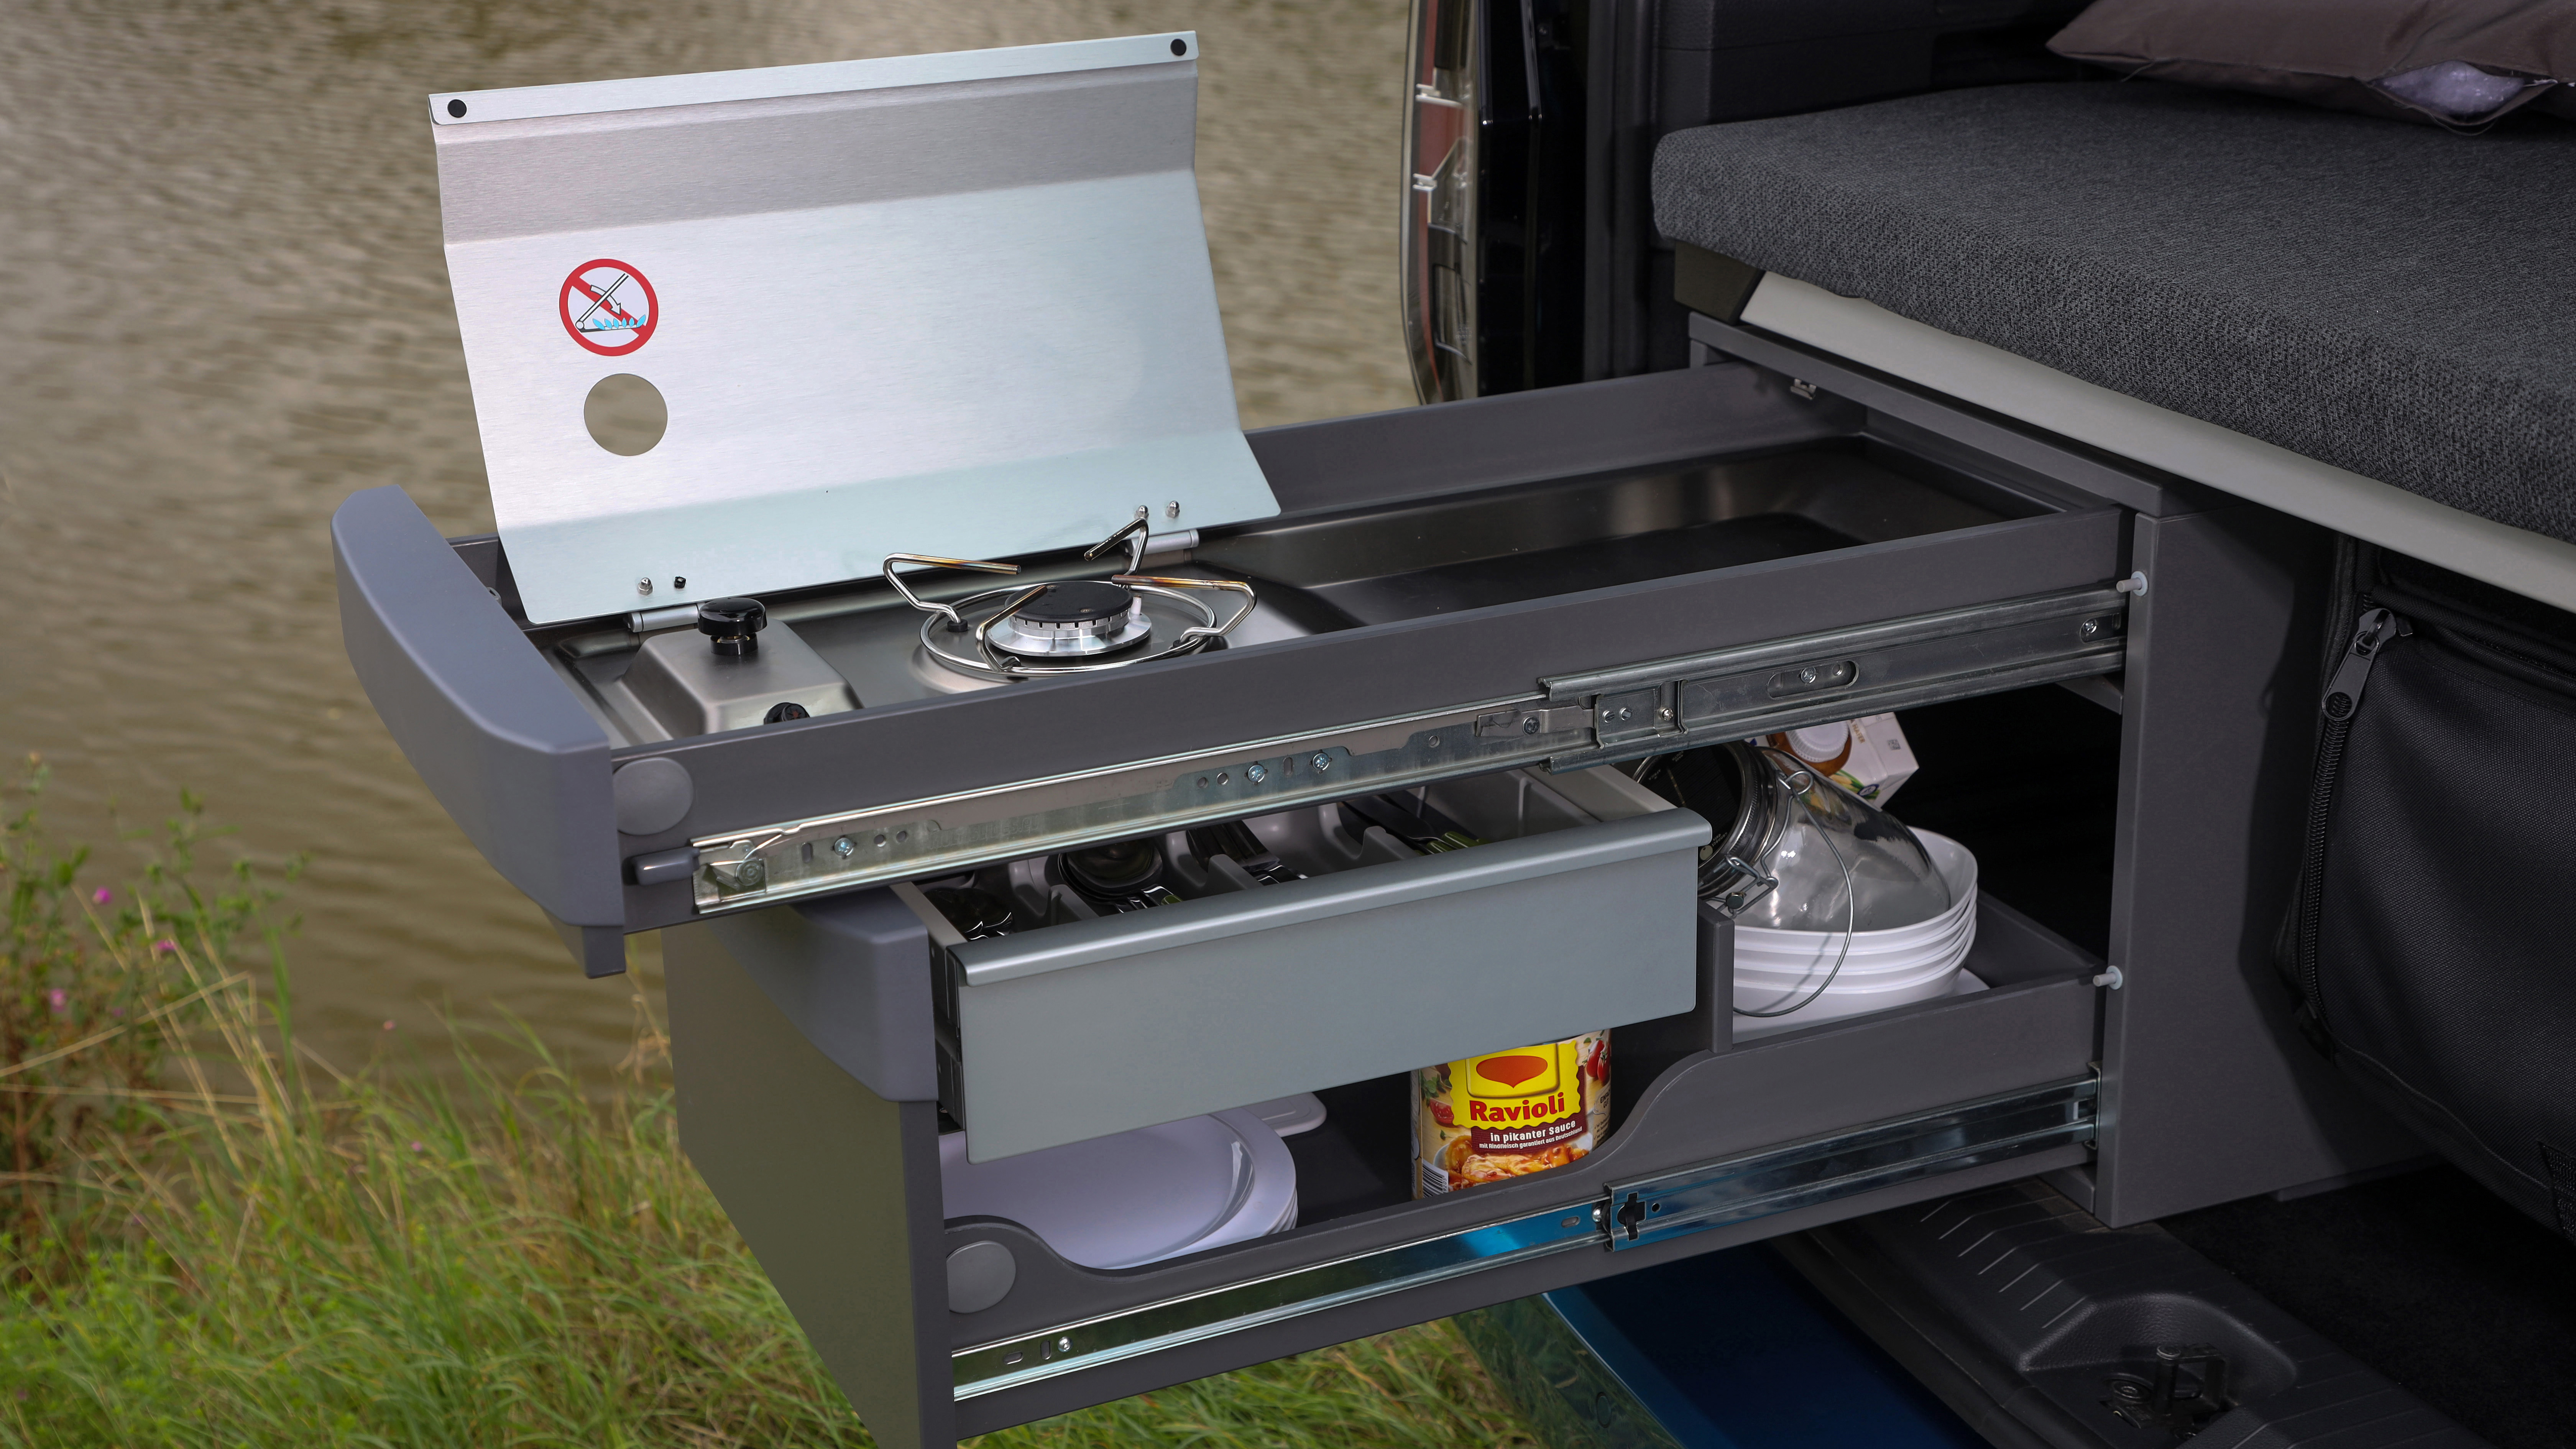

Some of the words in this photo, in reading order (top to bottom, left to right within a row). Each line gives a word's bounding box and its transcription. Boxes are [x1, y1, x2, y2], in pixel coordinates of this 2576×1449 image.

[1712, 832, 1728, 846] connect
[1469, 1092, 1565, 1122] Ravioli
[1490, 1132, 1500, 1142] in
[1503, 1129, 1546, 1143] pikanter
[1520, 1139, 1545, 1149] garantiert
[1556, 1126, 1582, 1141] Deutschland
